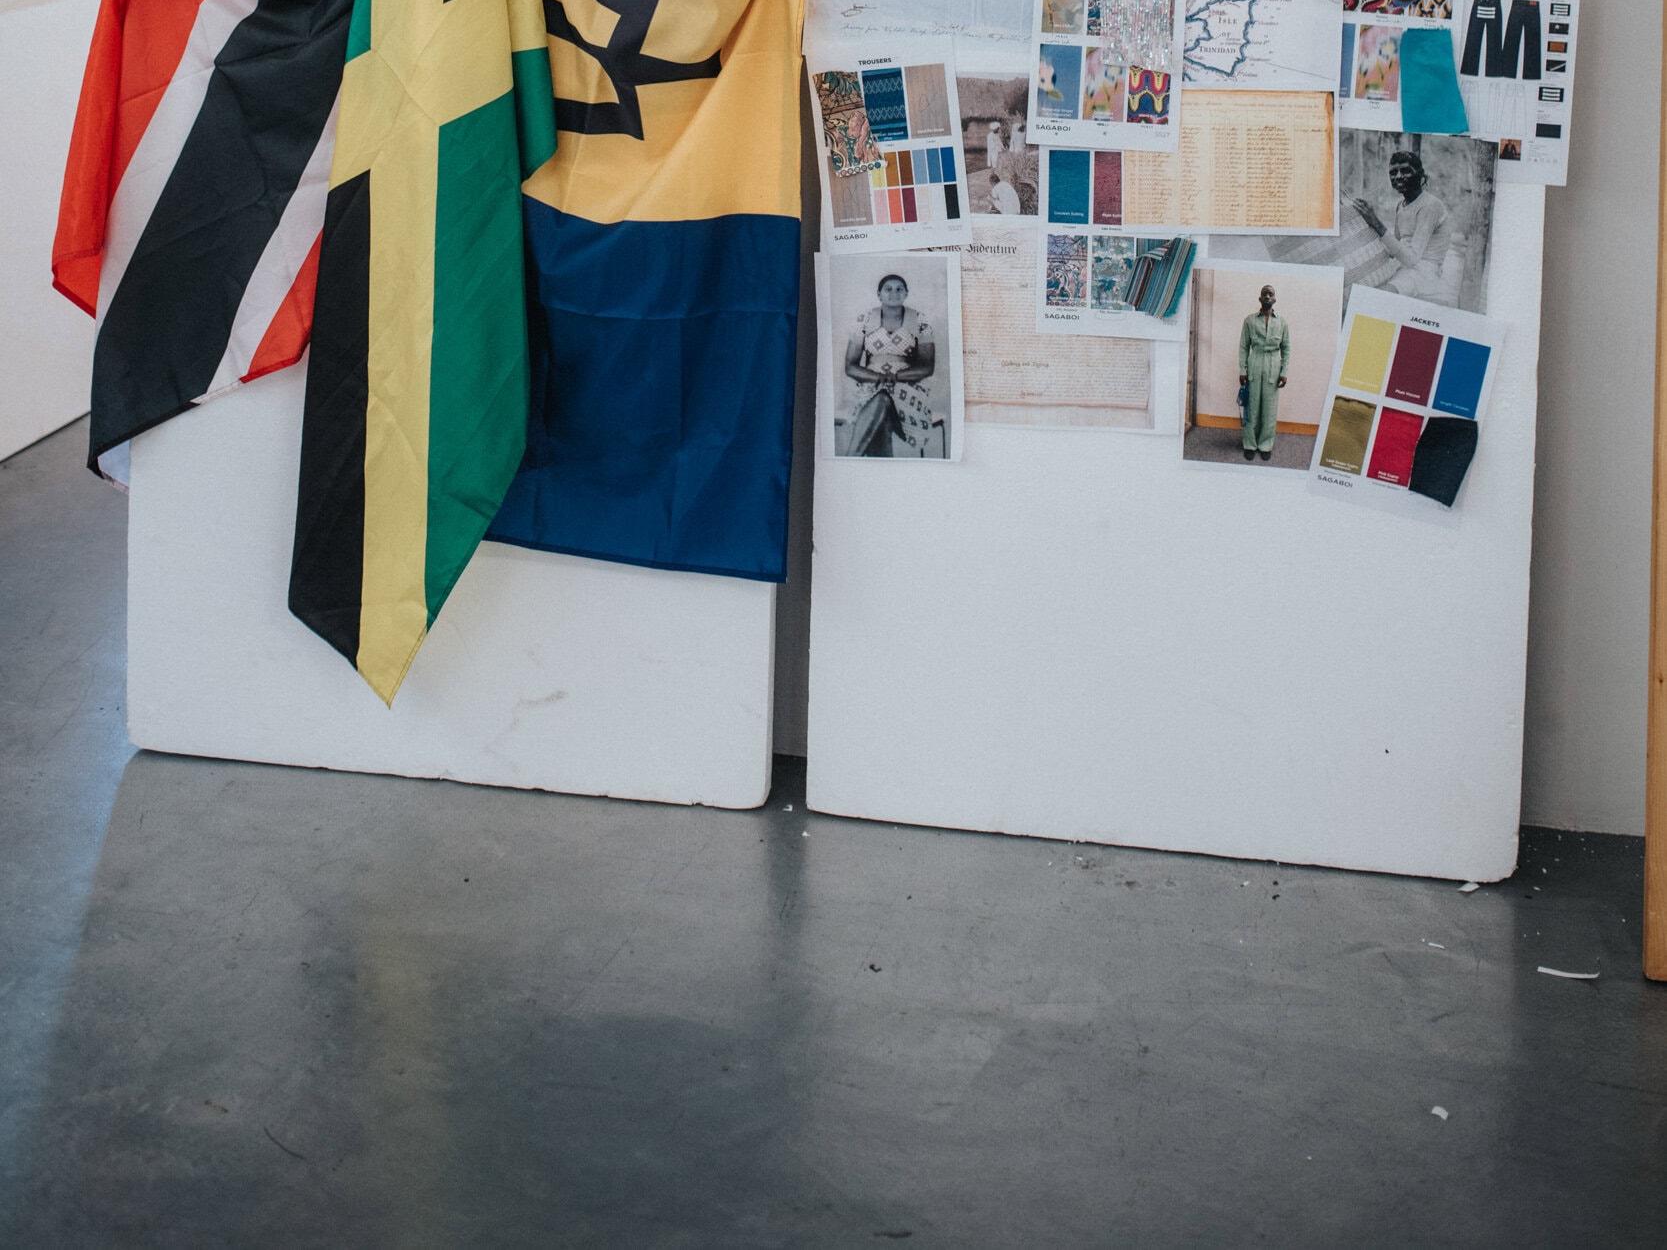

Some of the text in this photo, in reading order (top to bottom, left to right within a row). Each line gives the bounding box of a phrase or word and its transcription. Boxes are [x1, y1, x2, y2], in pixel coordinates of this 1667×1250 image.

[1199, 46, 1236, 54] TRINIDAD
[858, 57, 892, 66] TROUSERS
[1035, 124, 1071, 132] SAGABOI
[834, 233, 868, 241] SAGABOI
[966, 243, 1017, 254] Indenture
[1044, 313, 1080, 321] SAGABOI
[1410, 316, 1440, 328] JACKETS
[1317, 474, 1353, 488] SAGABOI
